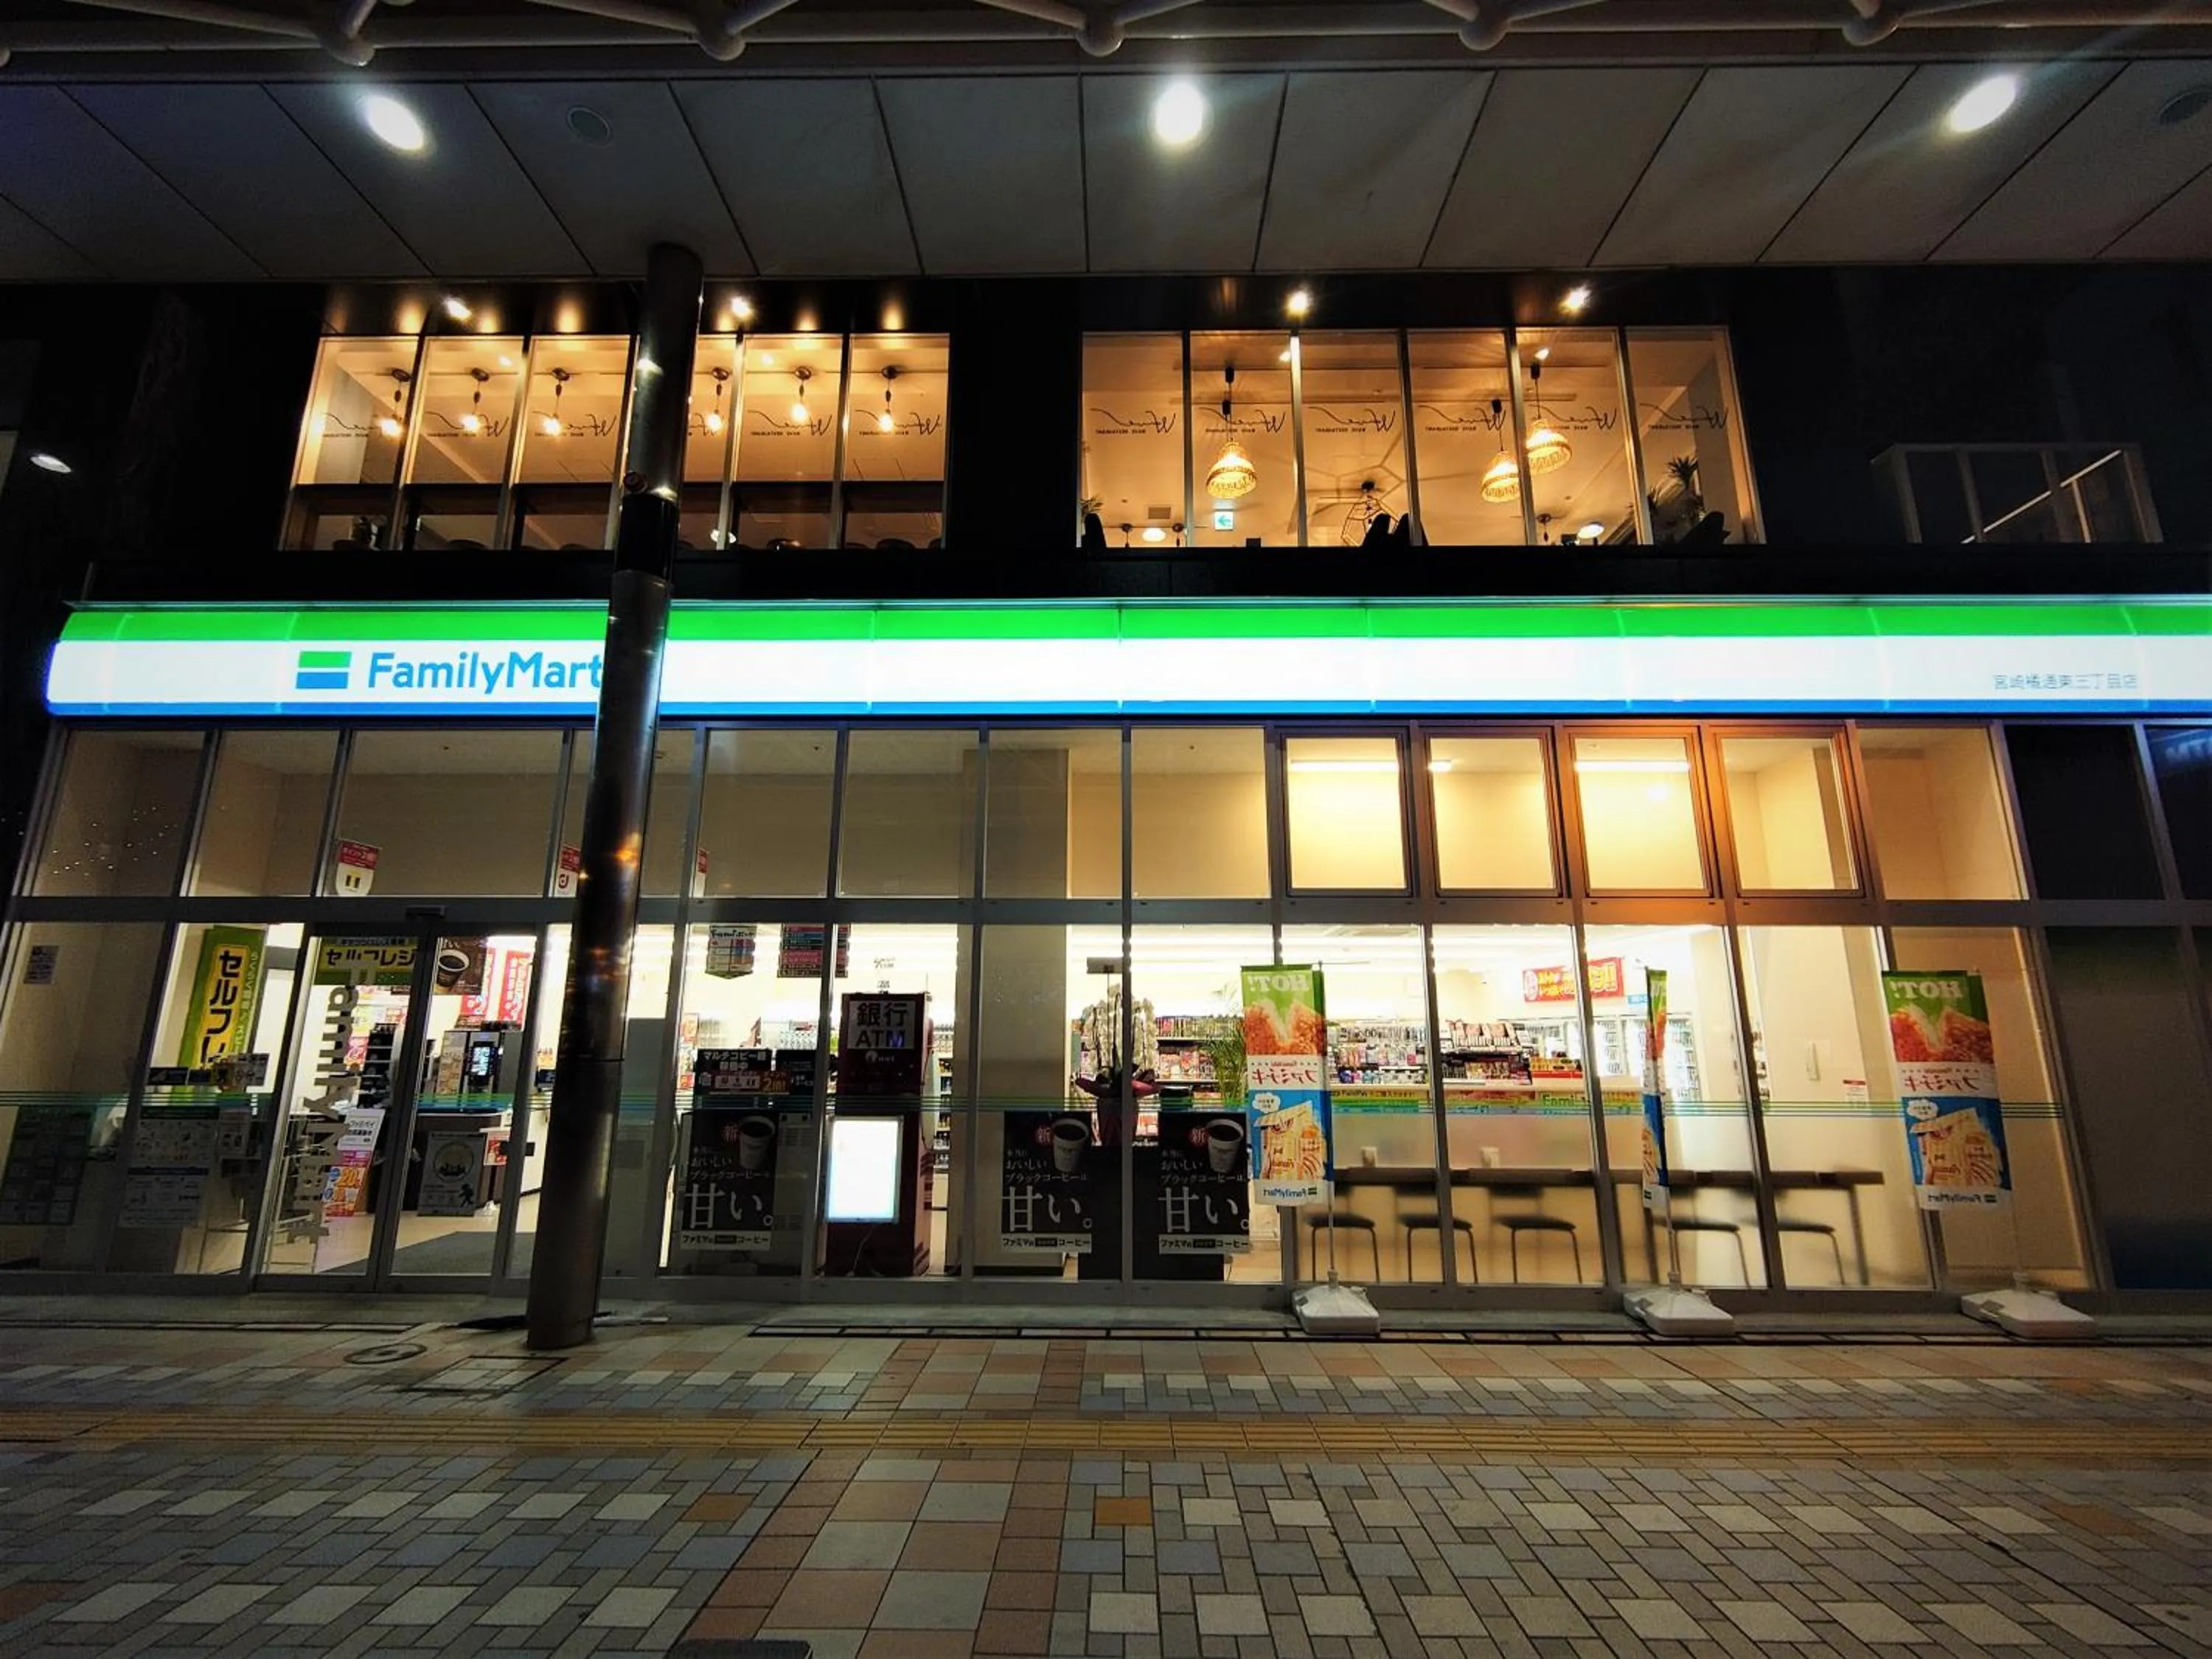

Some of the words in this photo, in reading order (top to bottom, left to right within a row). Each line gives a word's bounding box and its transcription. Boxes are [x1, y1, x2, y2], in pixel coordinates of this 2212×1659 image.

[369, 651, 602, 695] FamilyMart
[857, 1002, 908, 1027] 銀行
[855, 1029, 905, 1048] ATM
[684, 1183, 773, 1229] 甘い。
[1002, 1185, 1093, 1232] 甘い。
[1158, 1186, 1250, 1234] 甘い。
